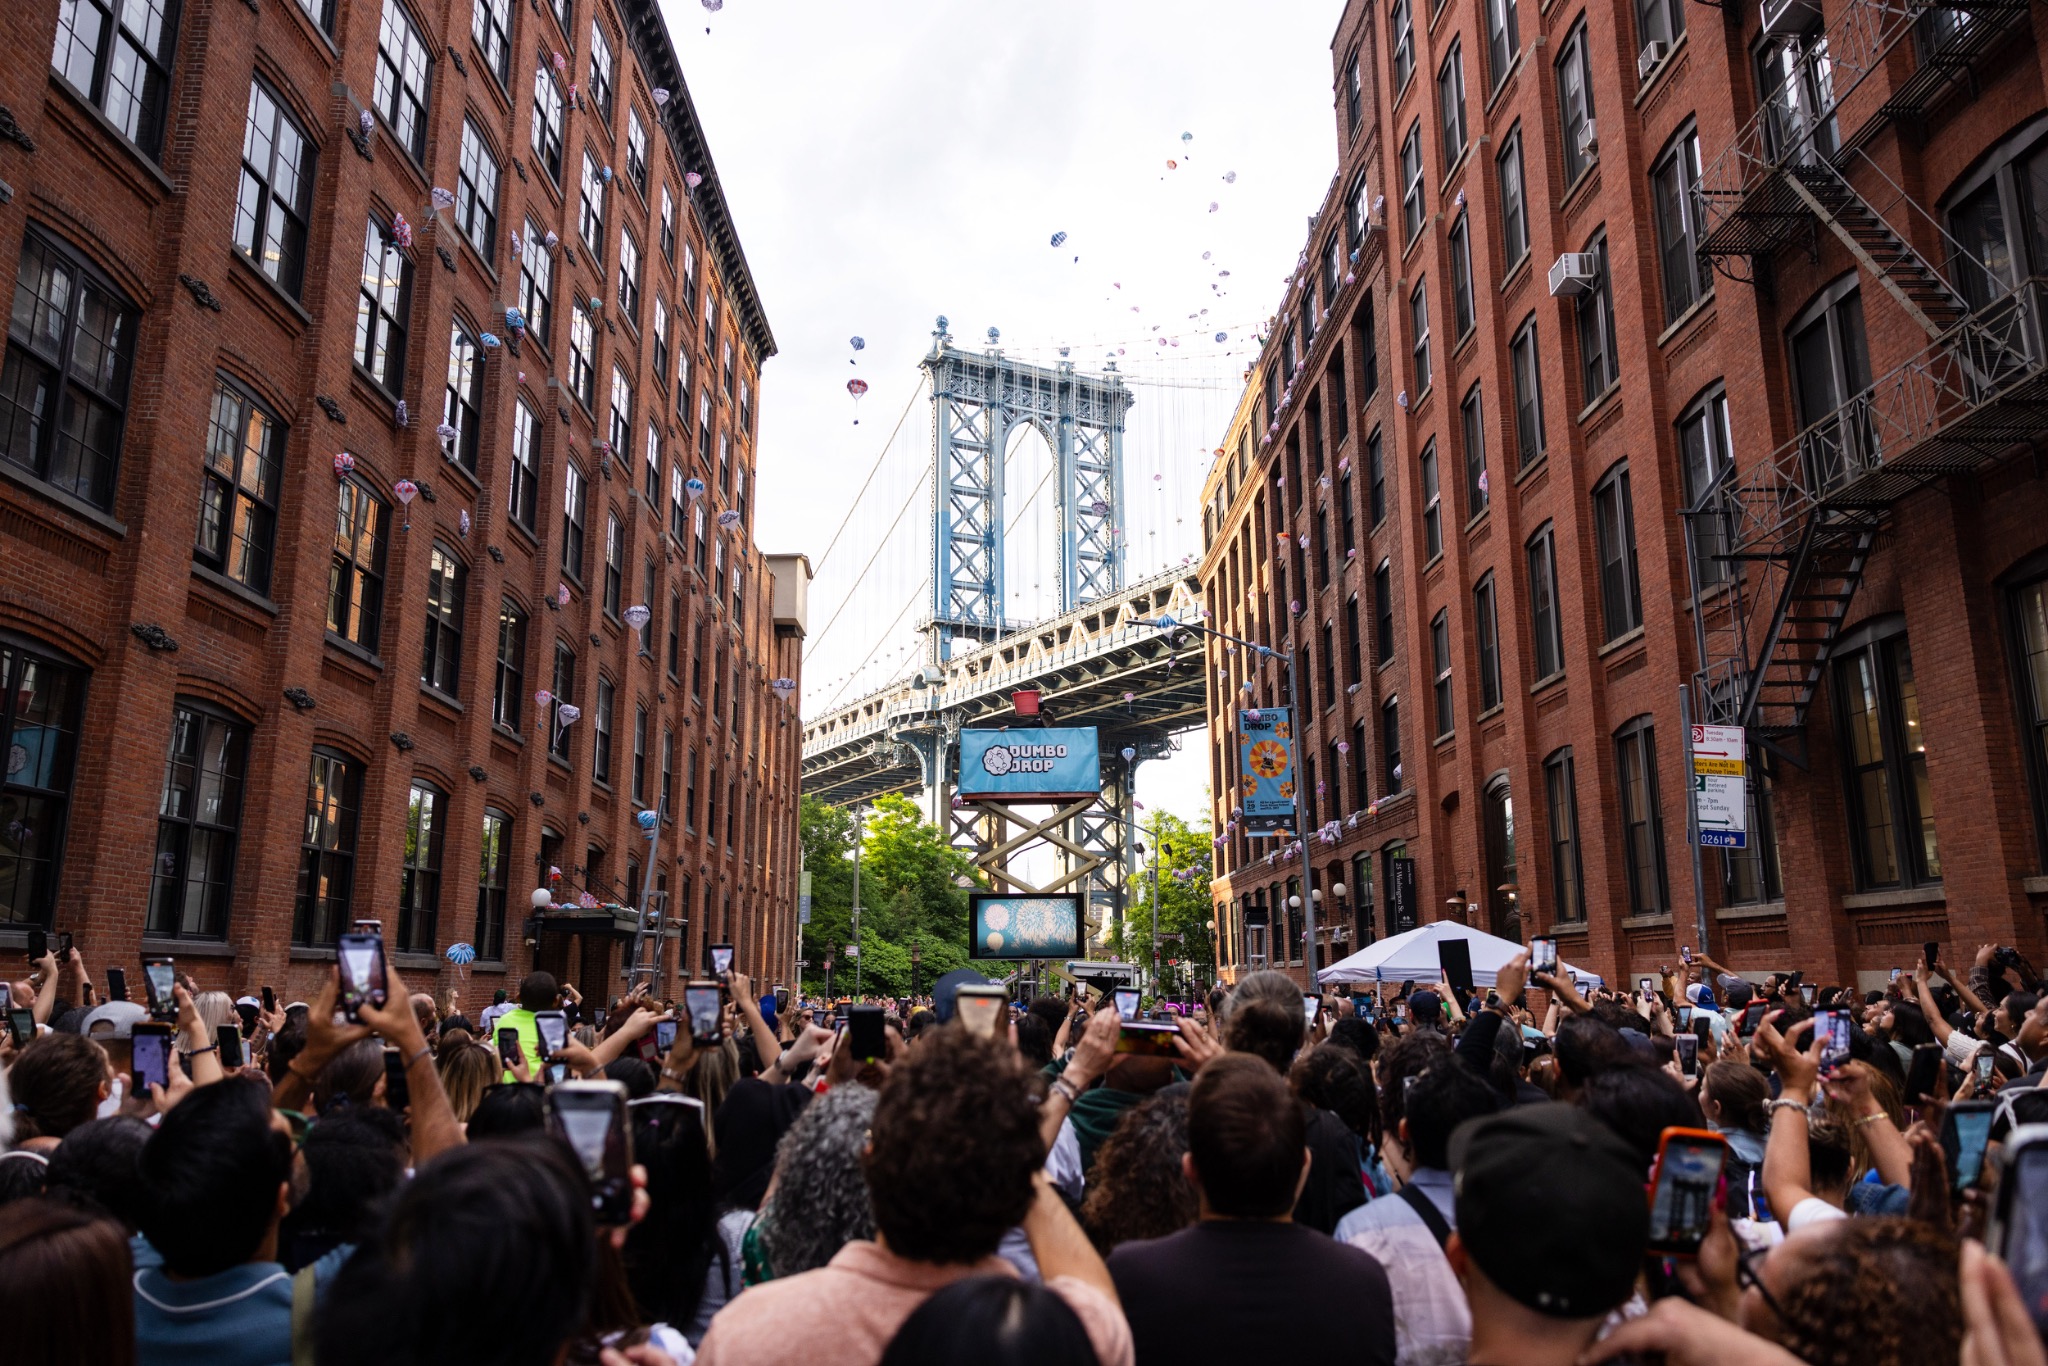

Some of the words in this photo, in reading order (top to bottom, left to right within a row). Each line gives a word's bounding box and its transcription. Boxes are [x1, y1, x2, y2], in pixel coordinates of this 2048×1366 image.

[1009, 744, 1068, 758] DUMBO
[1009, 759, 1054, 773] DROP
[1710, 804, 1730, 812] Sunday
